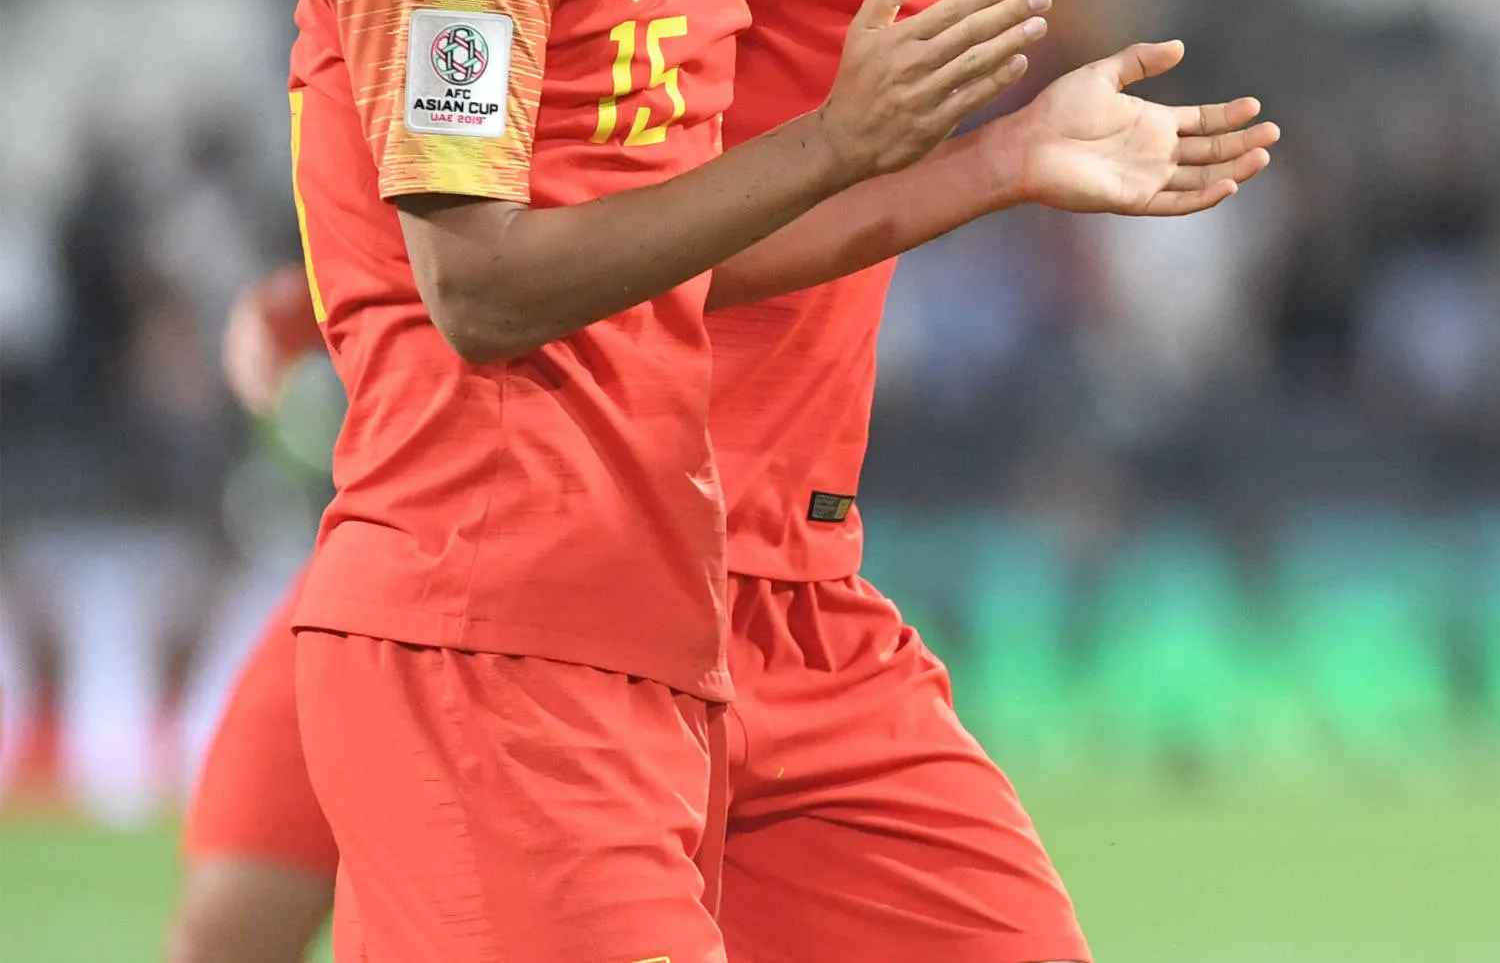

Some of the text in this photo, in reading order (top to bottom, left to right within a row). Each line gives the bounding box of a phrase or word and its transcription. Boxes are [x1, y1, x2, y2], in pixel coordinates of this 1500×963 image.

[590, 15, 688, 147] 15
[445, 88, 472, 100] AFC
[413, 98, 499, 115] ASIAN CUP
[430, 112, 453, 123] UAE
